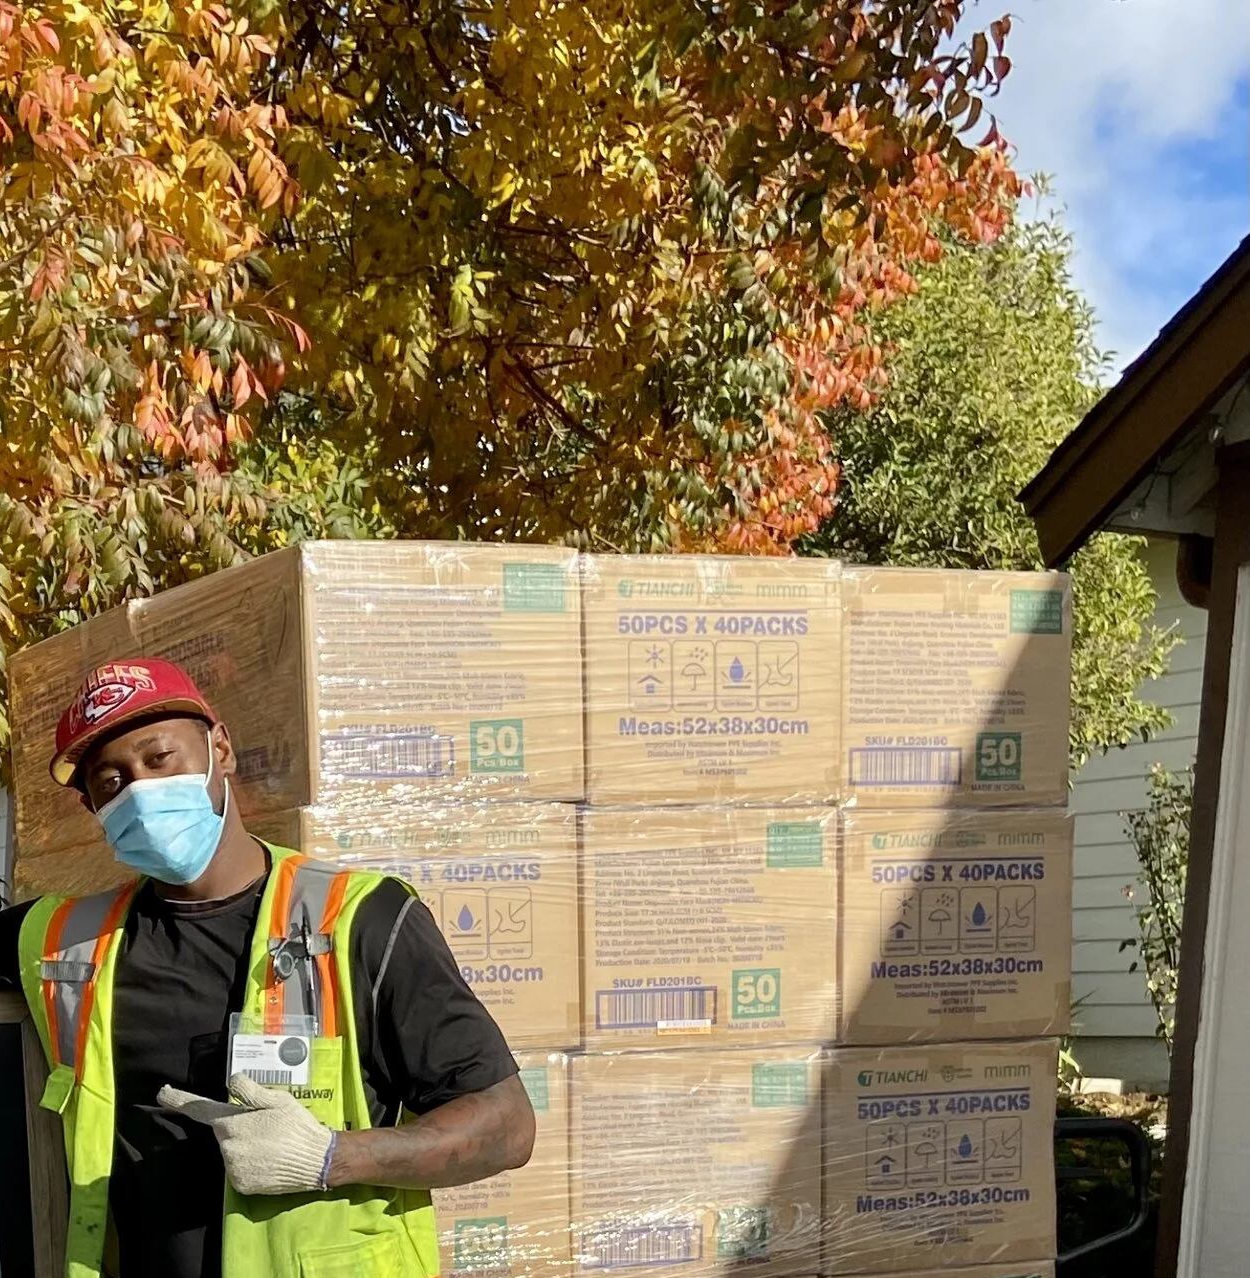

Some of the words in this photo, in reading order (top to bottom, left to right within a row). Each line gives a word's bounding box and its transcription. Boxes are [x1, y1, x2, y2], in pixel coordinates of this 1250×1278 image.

[618, 616, 688, 634] 50PCS
[695, 616, 707, 634] X
[714, 616, 808, 635] 40PACKS
[619, 717, 809, 736] Meas:52x38x30cm
[476, 725, 519, 756] 50
[981, 738, 1017, 766] 50
[441, 863, 541, 881] 40PACKS
[872, 865, 935, 883] 50PCS
[941, 865, 952, 881] X
[959, 863, 1044, 880] 40PACKS
[871, 958, 1043, 979] Meas:52x38x30cm
[646, 976, 702, 987] FLD201BC
[737, 974, 776, 1004] 50
[876, 1069, 928, 1084] TIANCHI
[289, 1086, 334, 1102] daway
[858, 1100, 921, 1119] 50PCS
[928, 1099, 939, 1115] X
[945, 1094, 1030, 1114] 40PACKS
[857, 1187, 1030, 1213] Meas:52x38x30cm
